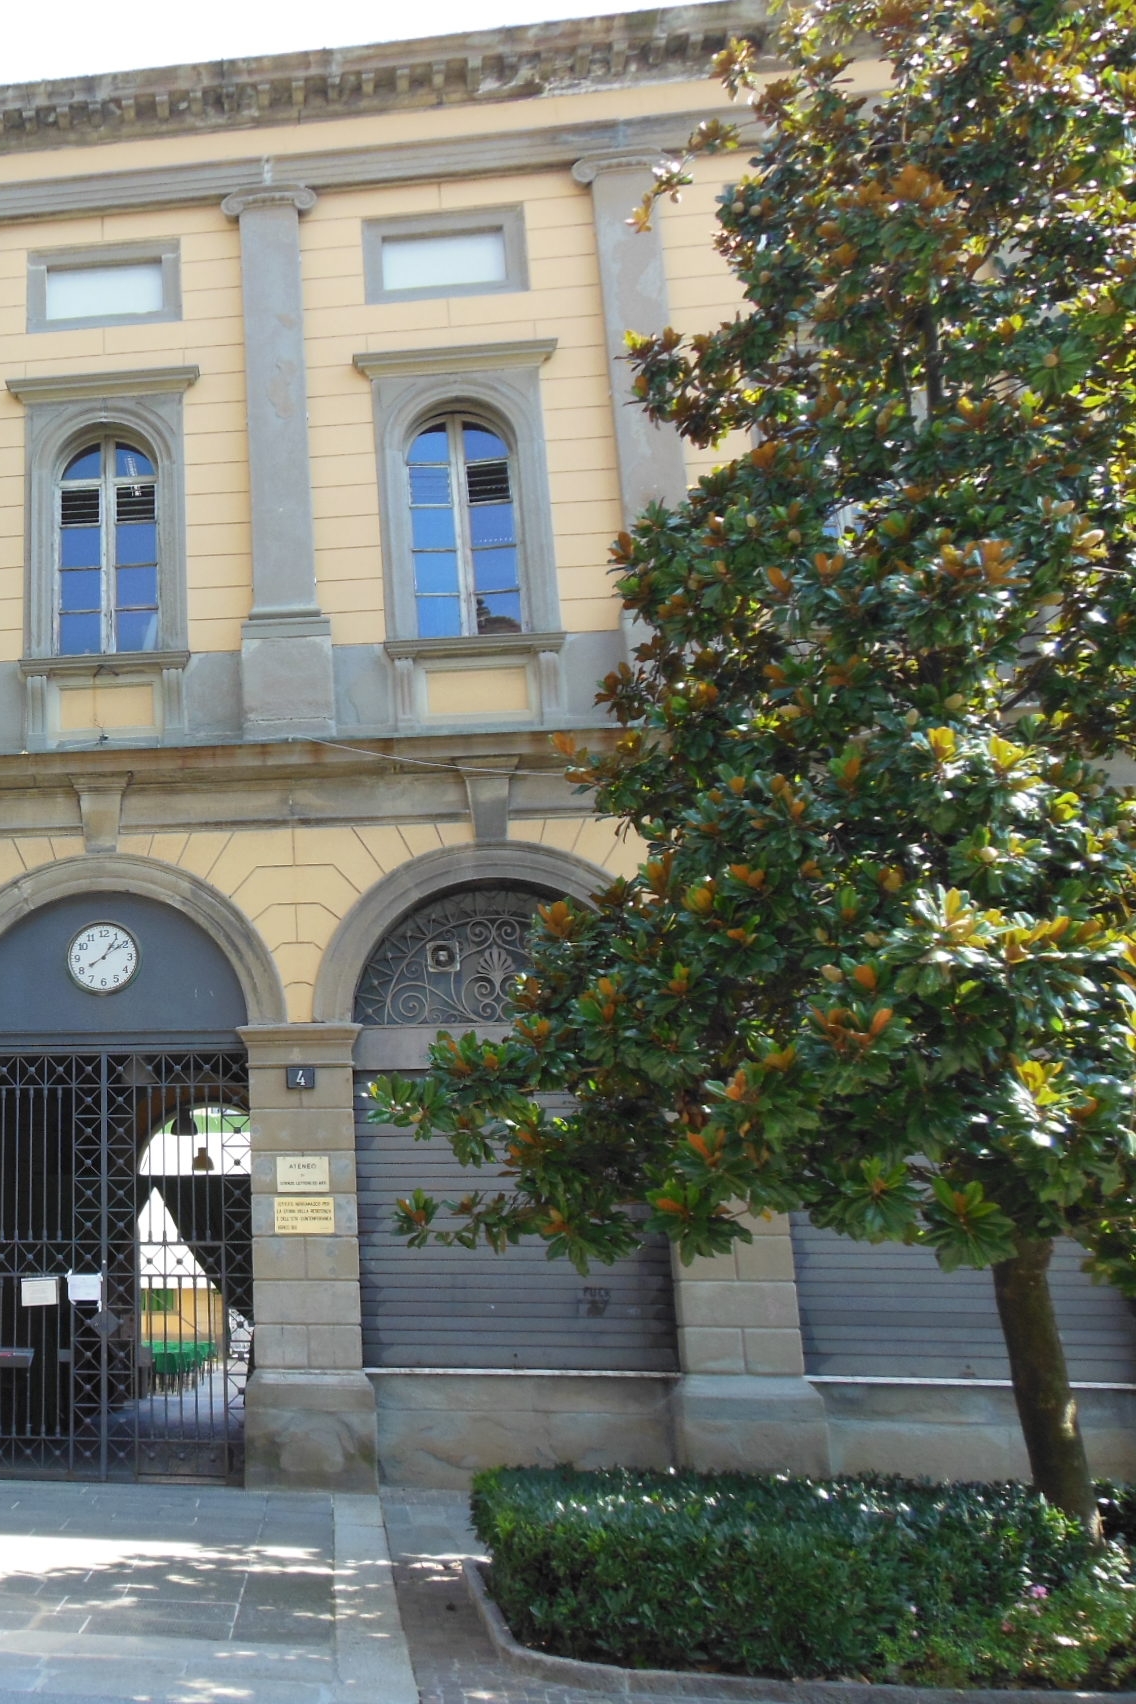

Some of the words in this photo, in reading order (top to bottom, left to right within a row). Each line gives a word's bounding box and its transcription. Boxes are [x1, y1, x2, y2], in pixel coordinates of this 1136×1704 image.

[86, 934, 95, 942] 11
[99, 930, 110, 938] 12
[113, 932, 118, 941] 1
[78, 943, 88, 951] 10
[122, 940, 129, 949] 2
[74, 955, 81, 963] 9
[127, 953, 133, 961] 3
[78, 967, 85, 975] 8
[122, 966, 129, 974] 4
[88, 975, 95, 984] 7
[100, 978, 107, 987] 6
[113, 975, 120, 983] 5
[296, 1070, 306, 1086] 4
